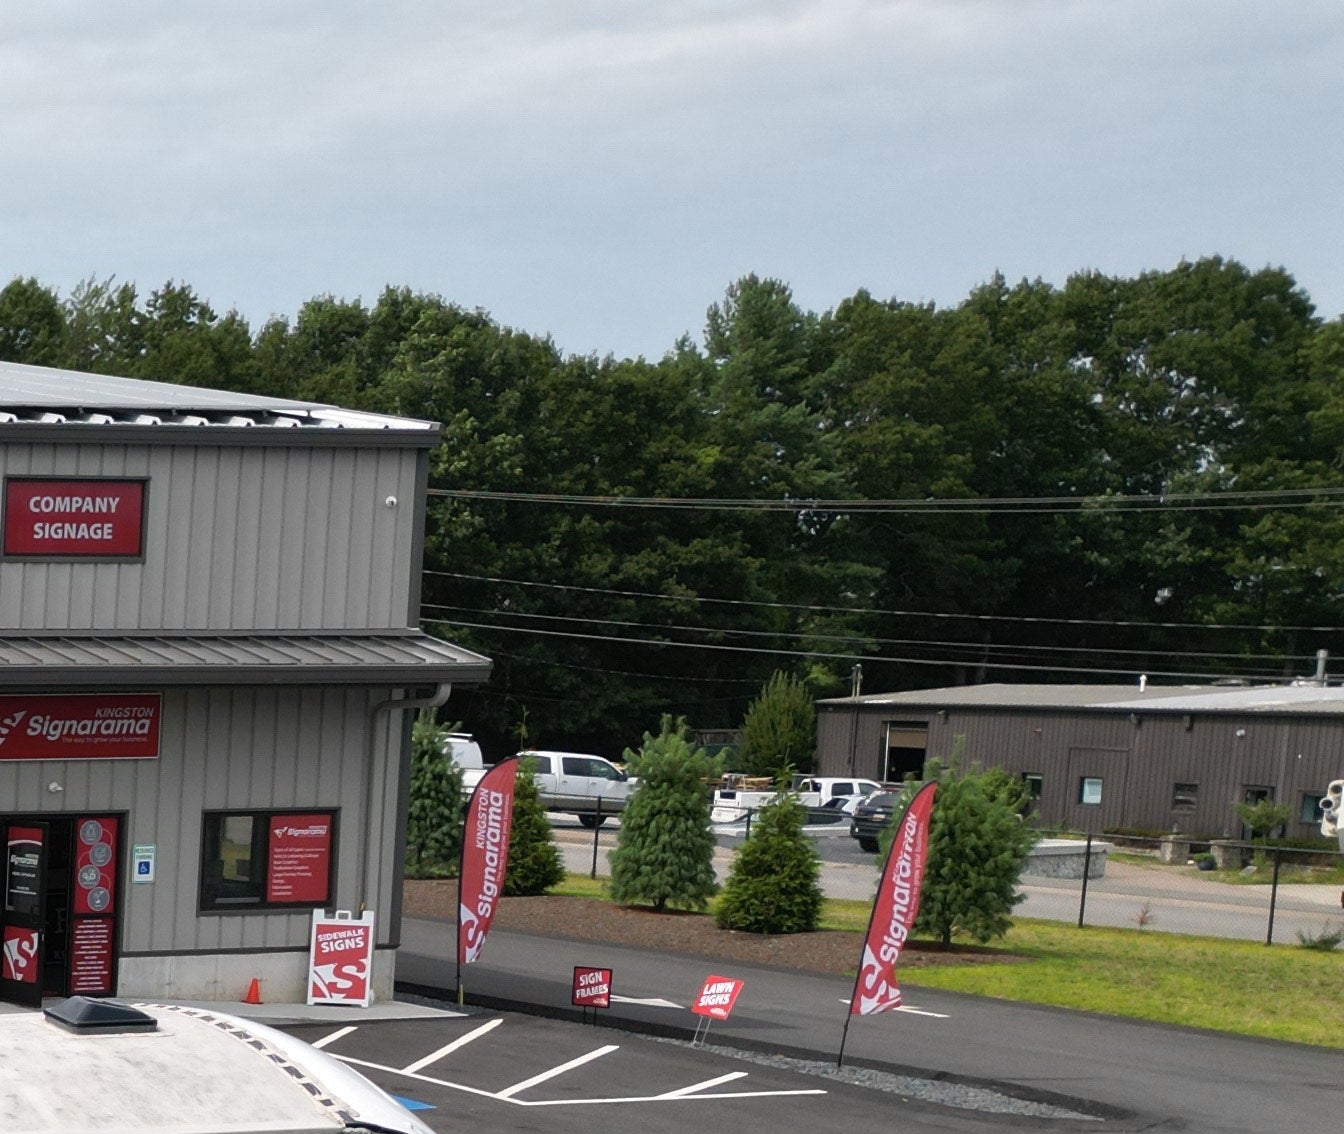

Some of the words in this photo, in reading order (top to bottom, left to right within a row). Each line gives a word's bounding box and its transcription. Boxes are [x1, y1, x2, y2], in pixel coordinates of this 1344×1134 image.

[29, 496, 120, 513] COMPANY
[33, 522, 113, 540] SIGNAGE
[95, 706, 154, 718] KINGSTON
[26, 714, 151, 741] Signarama
[475, 787, 489, 849] KINGSTON
[477, 791, 503, 918] Signarama
[317, 928, 364, 942] SIDEWALK
[320, 937, 364, 953] SIGNS
[579, 971, 603, 986] SIGN
[576, 984, 609, 999] FRAMES
[703, 981, 736, 995] LAWN
[698, 993, 731, 1007] SIGNS
